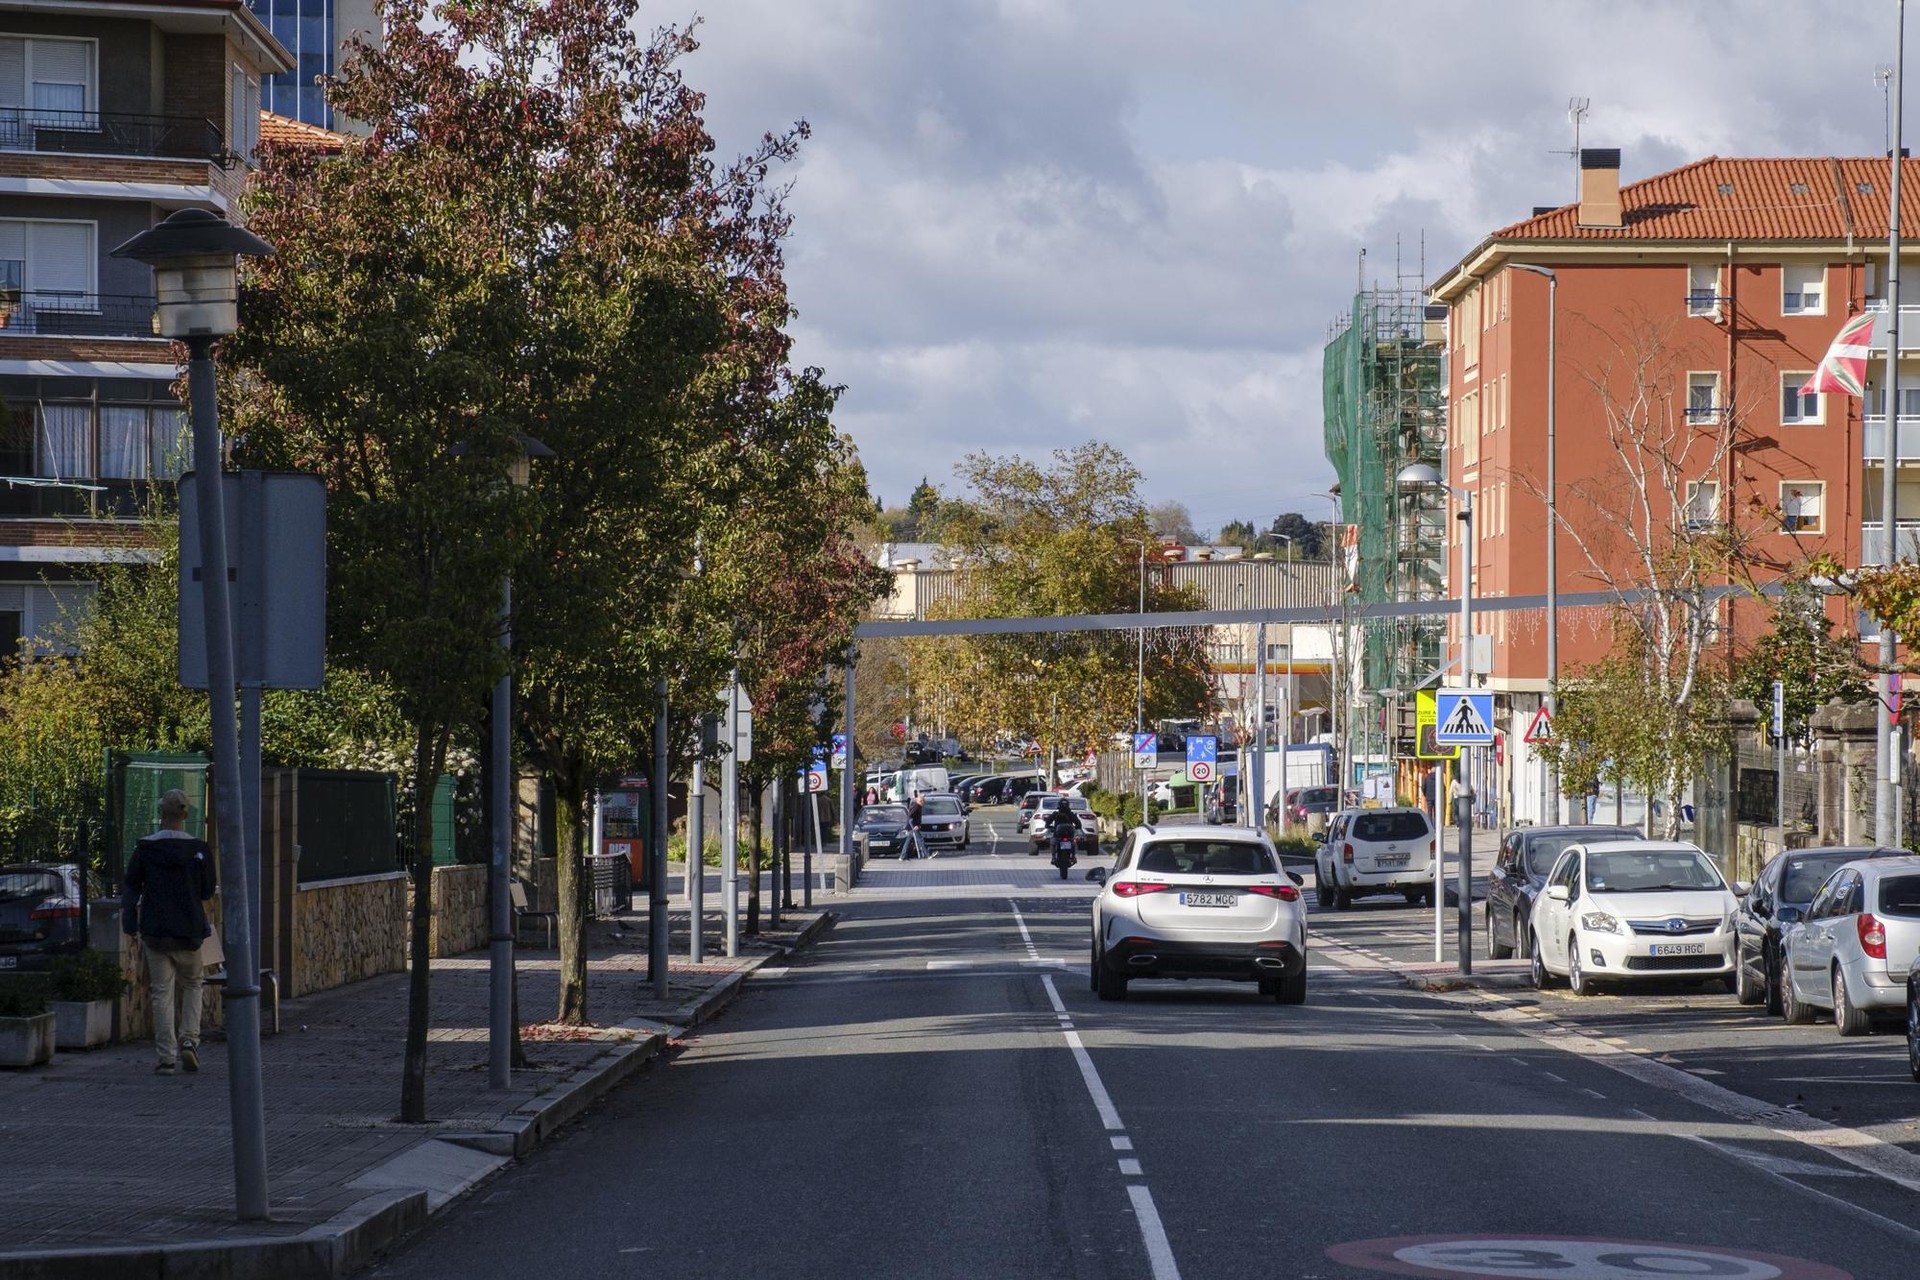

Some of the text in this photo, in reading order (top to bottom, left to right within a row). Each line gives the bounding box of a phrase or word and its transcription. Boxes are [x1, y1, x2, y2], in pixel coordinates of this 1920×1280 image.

[1196, 767, 1206, 775] 20
[1187, 894, 1234, 905] 5782 MGC
[1657, 944, 1703, 955] 6649 HGC
[1429, 1248, 1750, 1276] 30
